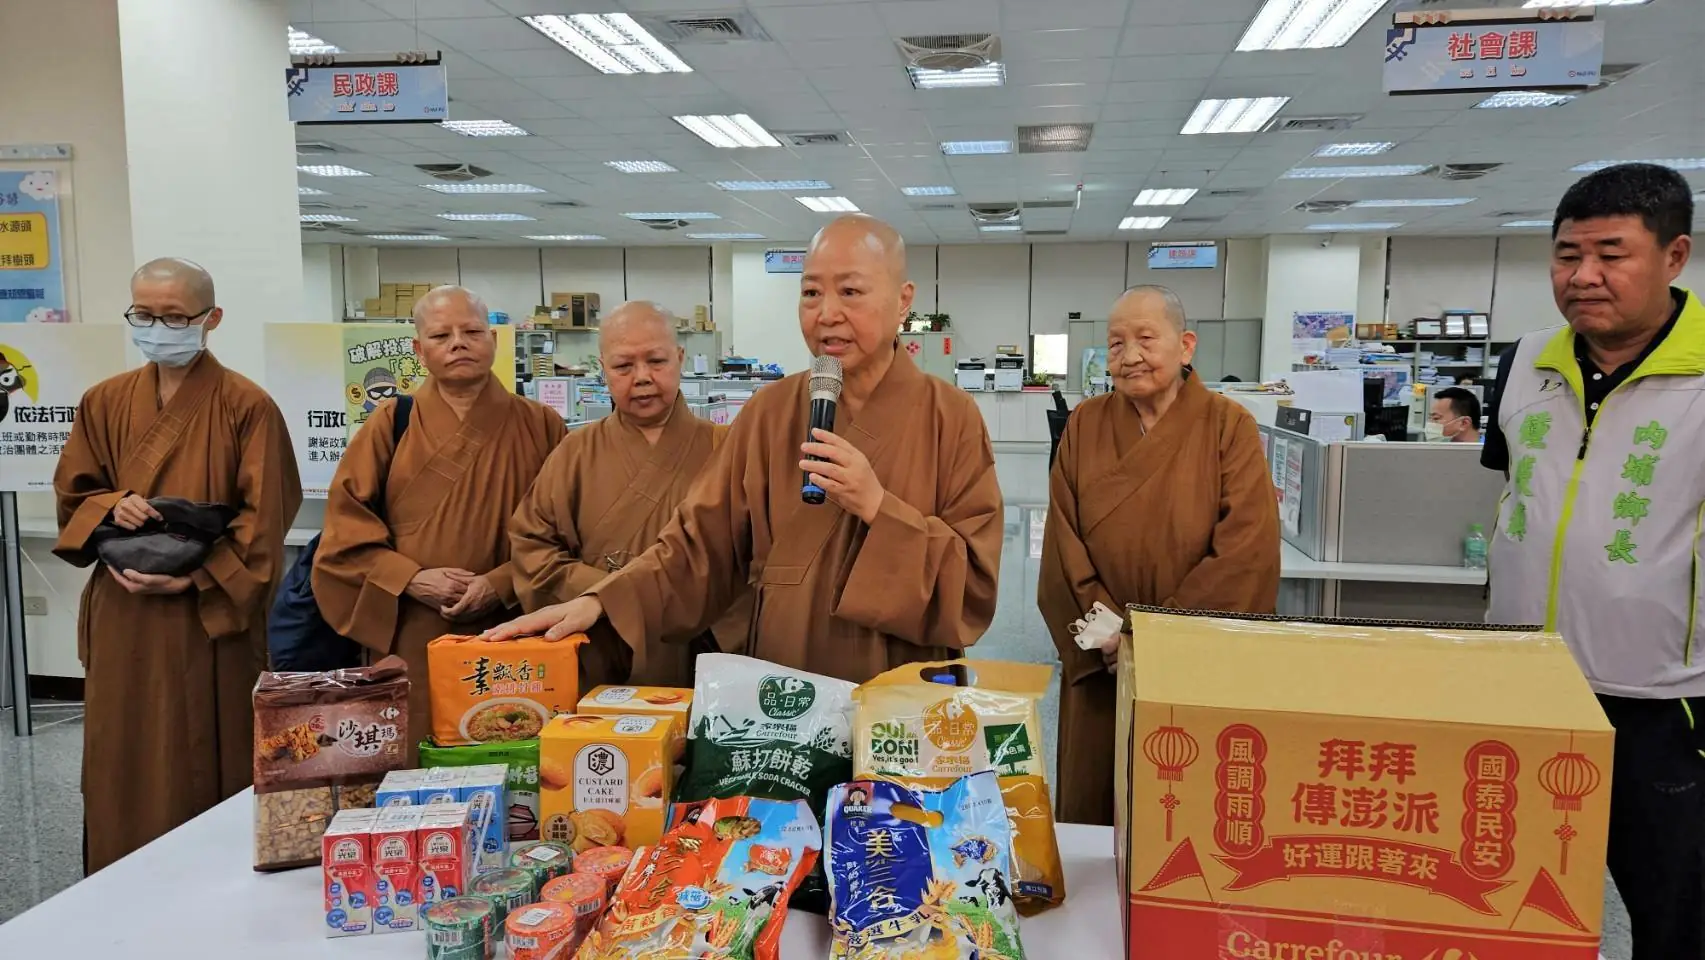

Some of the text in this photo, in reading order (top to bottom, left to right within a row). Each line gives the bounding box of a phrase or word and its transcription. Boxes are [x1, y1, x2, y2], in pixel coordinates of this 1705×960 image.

[1448, 30, 1538, 60] 社會課
[332, 72, 400, 97] 民政課
[0, 432, 70, 442] 班或勤務時間
[0, 445, 64, 455] 治團體之活
[461, 657, 534, 696] 素飄香
[768, 707, 799, 717] Classic
[339, 720, 395, 751] 沙琪瑪
[756, 730, 798, 740] Carrefour
[872, 722, 905, 738] OUI
[872, 739, 919, 755] BON!
[592, 752, 609, 771] 濃
[731, 748, 813, 780] 蘇打餅乾
[932, 765, 972, 773] Carrefour
[1317, 738, 1418, 785] 拜拜
[579, 778, 623, 786] CUSTARD
[758, 772, 779, 782] SODA
[781, 776, 811, 797] CRACKER
[1226, 736, 1255, 847] 風調雨順
[844, 805, 872, 814] QUAKER
[1291, 782, 1440, 834] 傳澎派
[1473, 754, 1508, 869] 國泰民安
[1282, 843, 1440, 881] 好運跟著來
